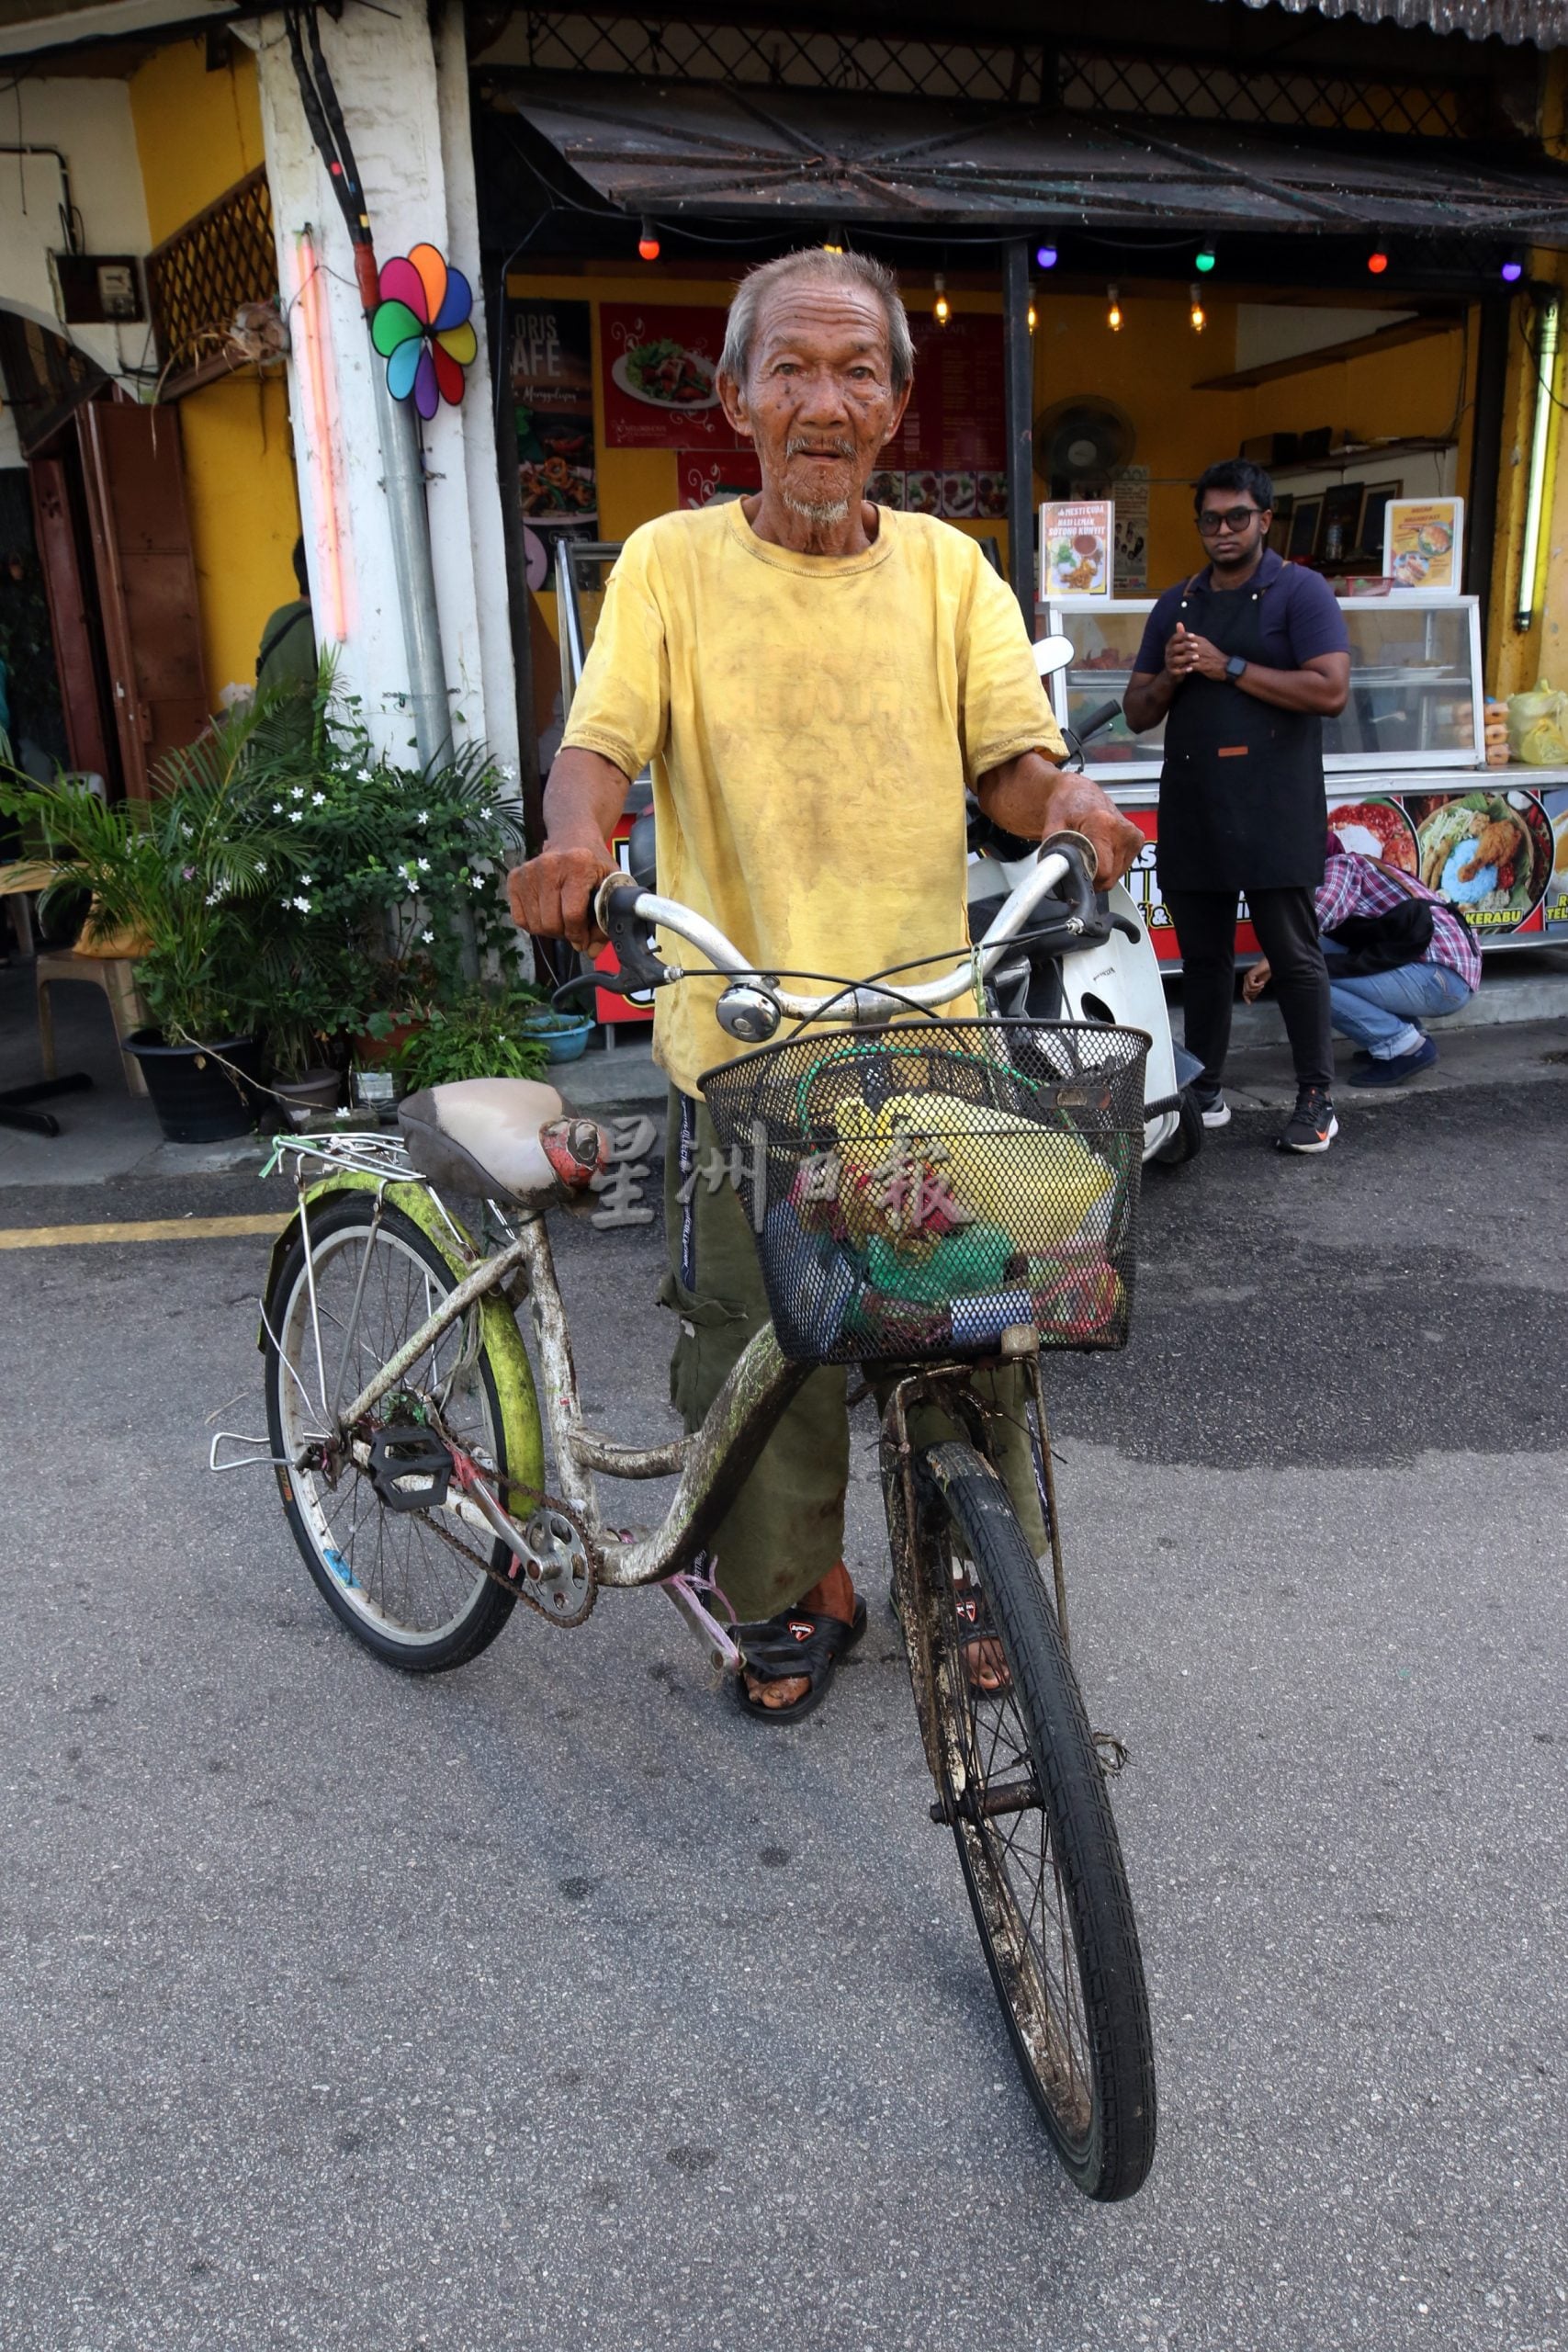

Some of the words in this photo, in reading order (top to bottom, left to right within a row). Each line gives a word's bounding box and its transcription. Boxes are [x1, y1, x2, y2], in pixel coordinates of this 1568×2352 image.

[511, 313, 558, 339] ORIS
[510, 339, 560, 377] AFE
[1048, 526, 1077, 537] SOTONG
[1465, 910, 1522, 926] KERABU
